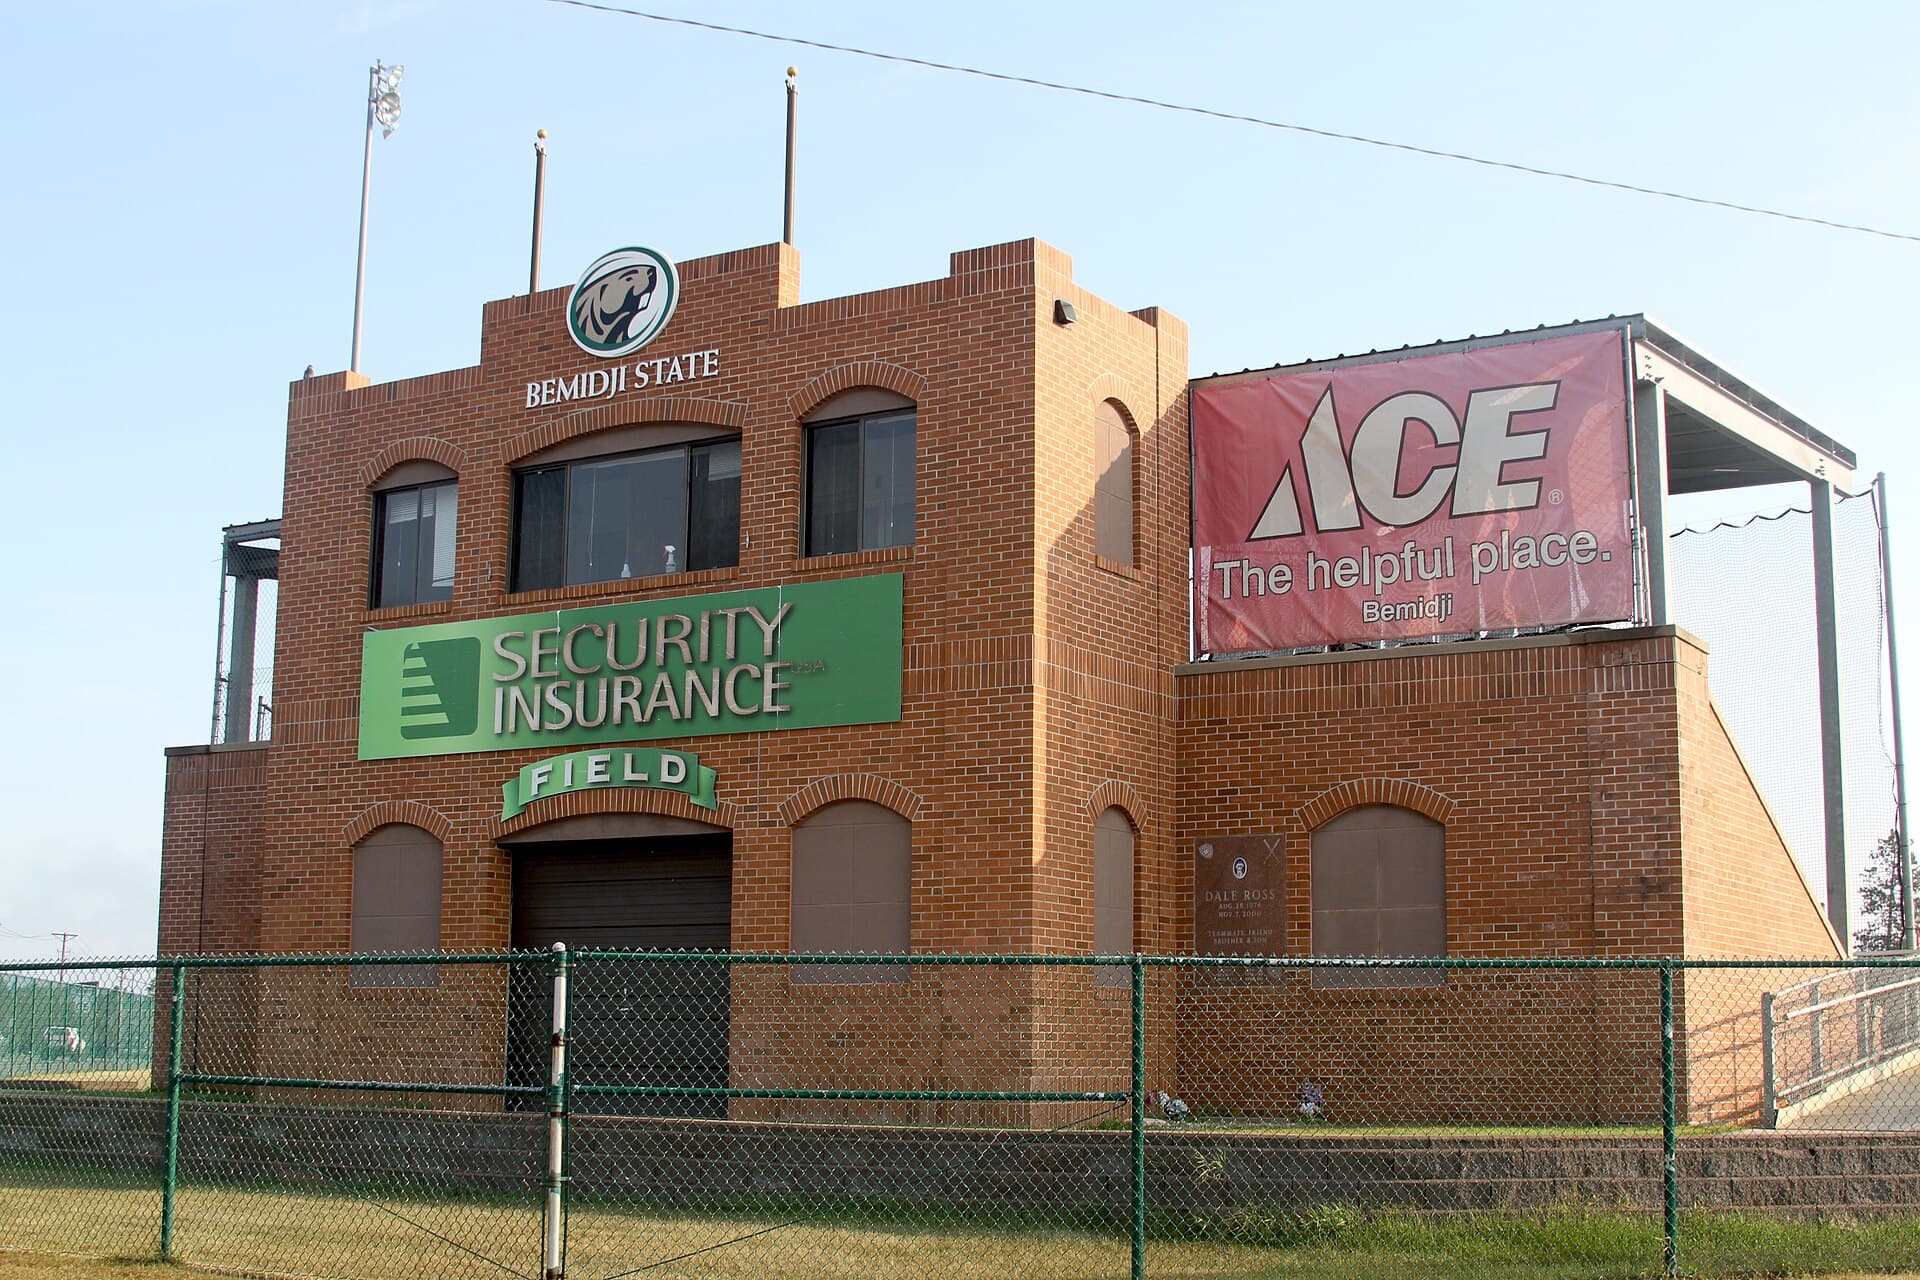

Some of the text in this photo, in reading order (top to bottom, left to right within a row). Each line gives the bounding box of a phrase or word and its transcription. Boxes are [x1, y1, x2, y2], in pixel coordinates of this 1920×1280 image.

[525, 349, 721, 409] BEMIDJI STATE
[1245, 380, 1562, 542] ACE
[1213, 529, 1612, 600] The helpful place.
[1363, 593, 1453, 624] Bemidji
[492, 601, 796, 682] SECURITY
[493, 662, 793, 735] INSURANCE
[530, 752, 687, 797] FIELD
[1205, 889, 1275, 902] DALE ROSS
